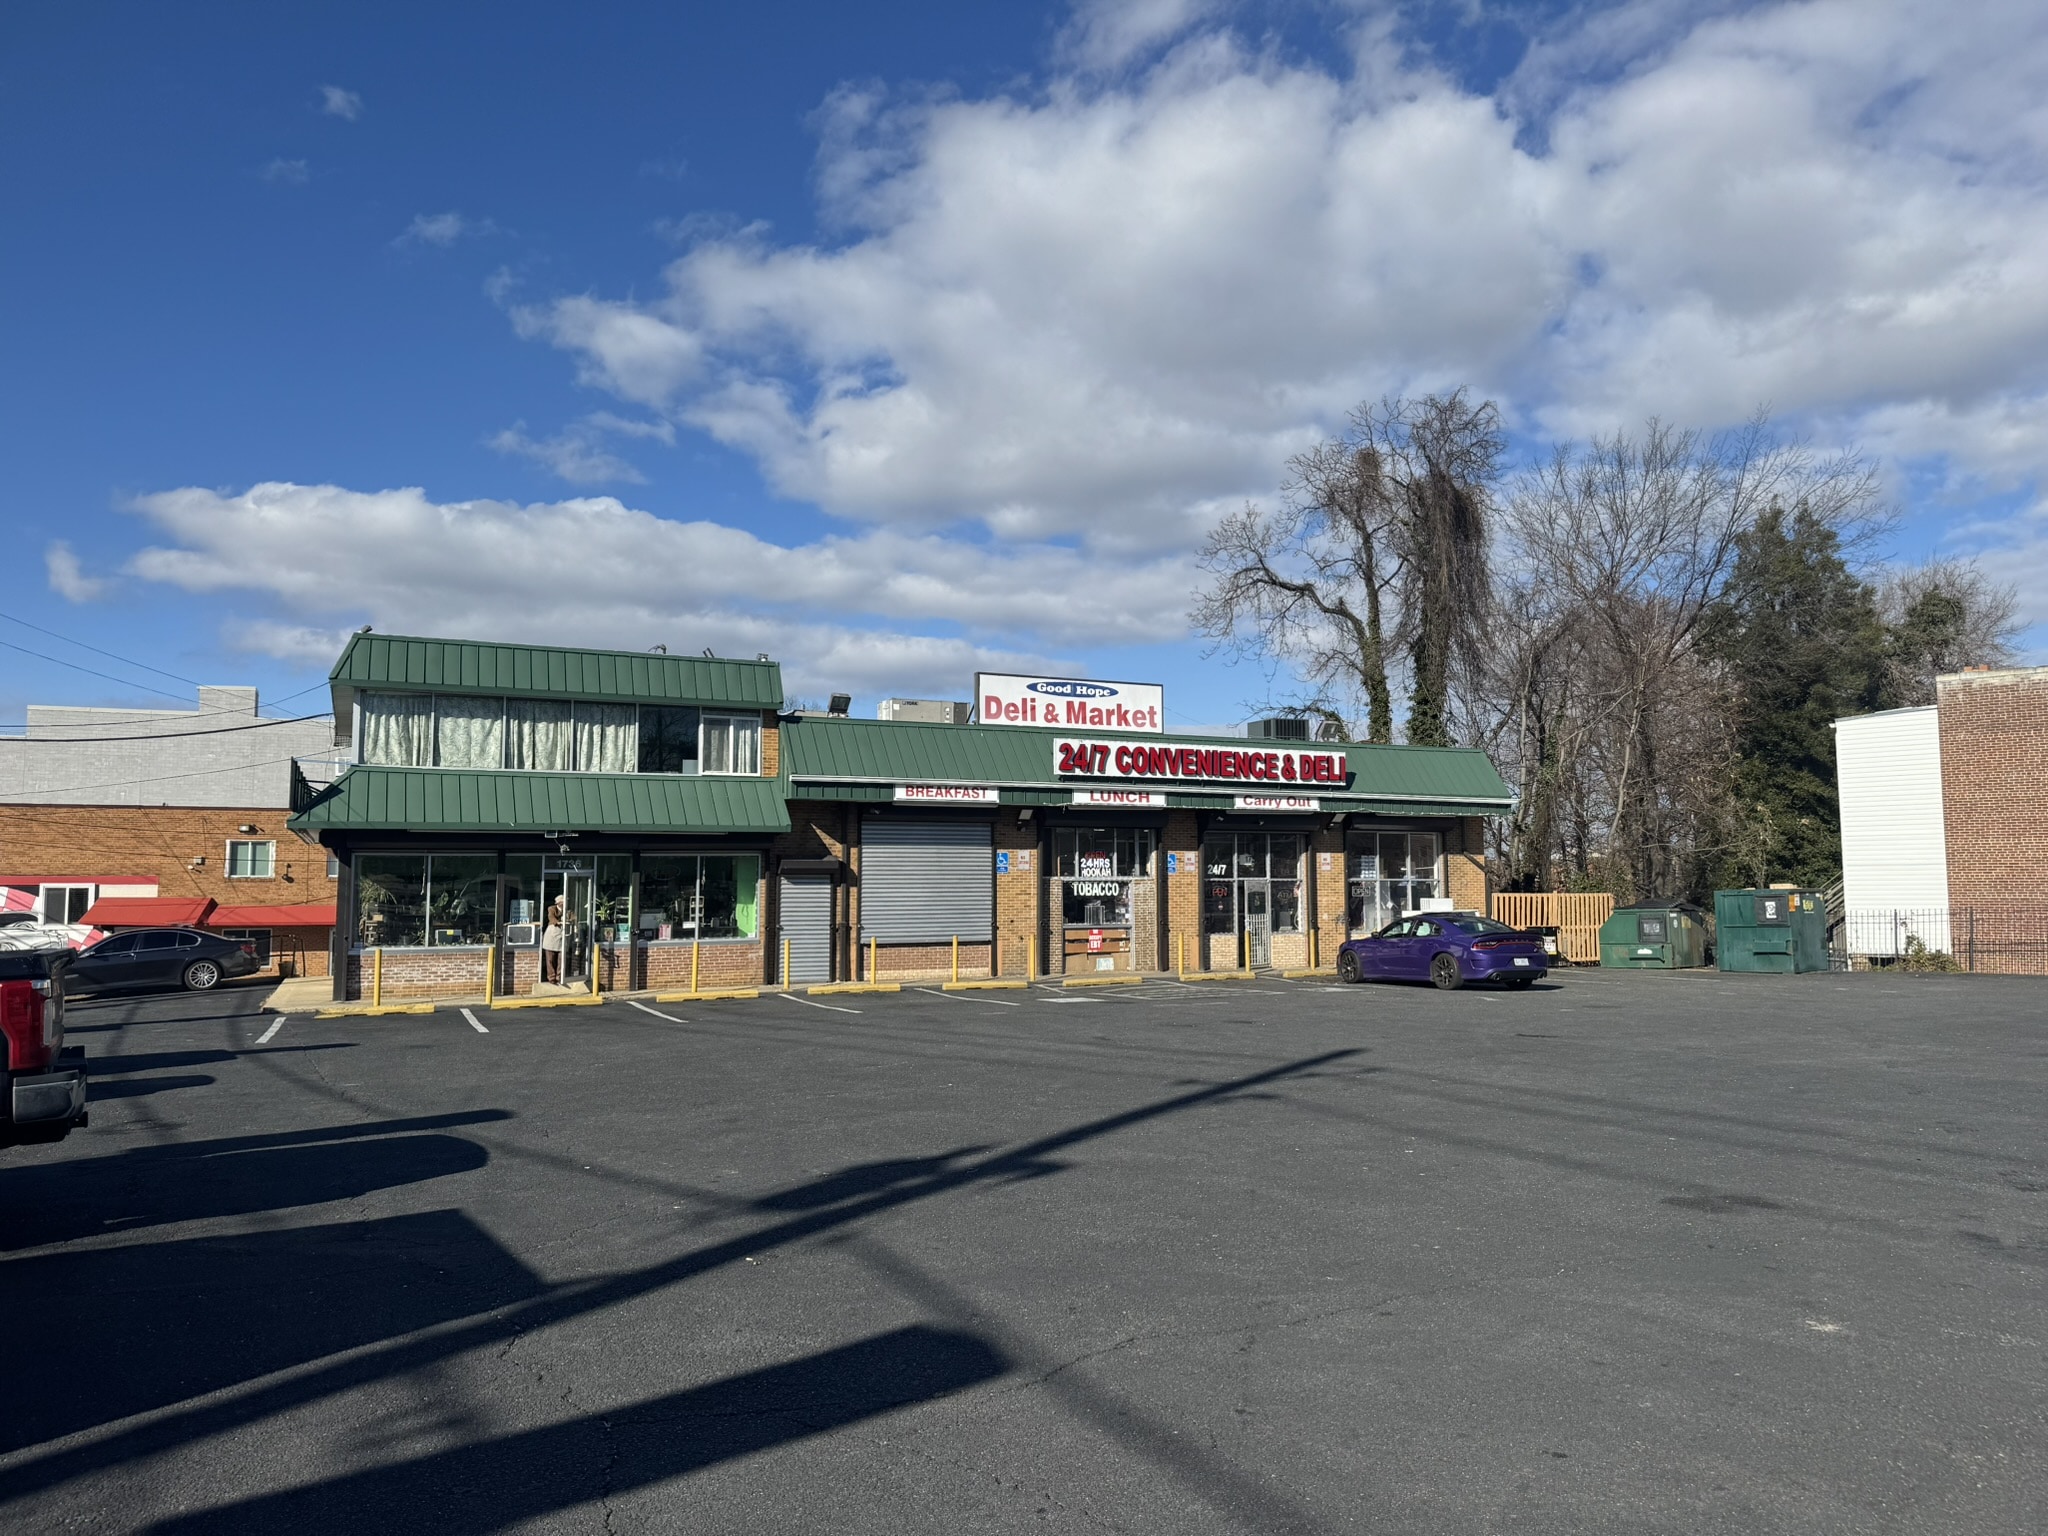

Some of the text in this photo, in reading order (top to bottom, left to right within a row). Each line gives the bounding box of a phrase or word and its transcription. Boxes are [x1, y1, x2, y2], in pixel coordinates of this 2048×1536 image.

[1036, 682, 1111, 698] Good Hope
[984, 695, 1158, 728] Deli & Market
[1058, 742, 1346, 784] 24/7 CONVENIENCE & DELI
[905, 784, 988, 799] BREAKFAST
[1089, 790, 1150, 803] LUNCH
[1243, 794, 1312, 809] Carry Out
[556, 859, 582, 869] 1736
[1207, 864, 1227, 875] 24/7
[1081, 867, 1112, 877] HOOKAH
[1072, 881, 1120, 896] TOBACCO
